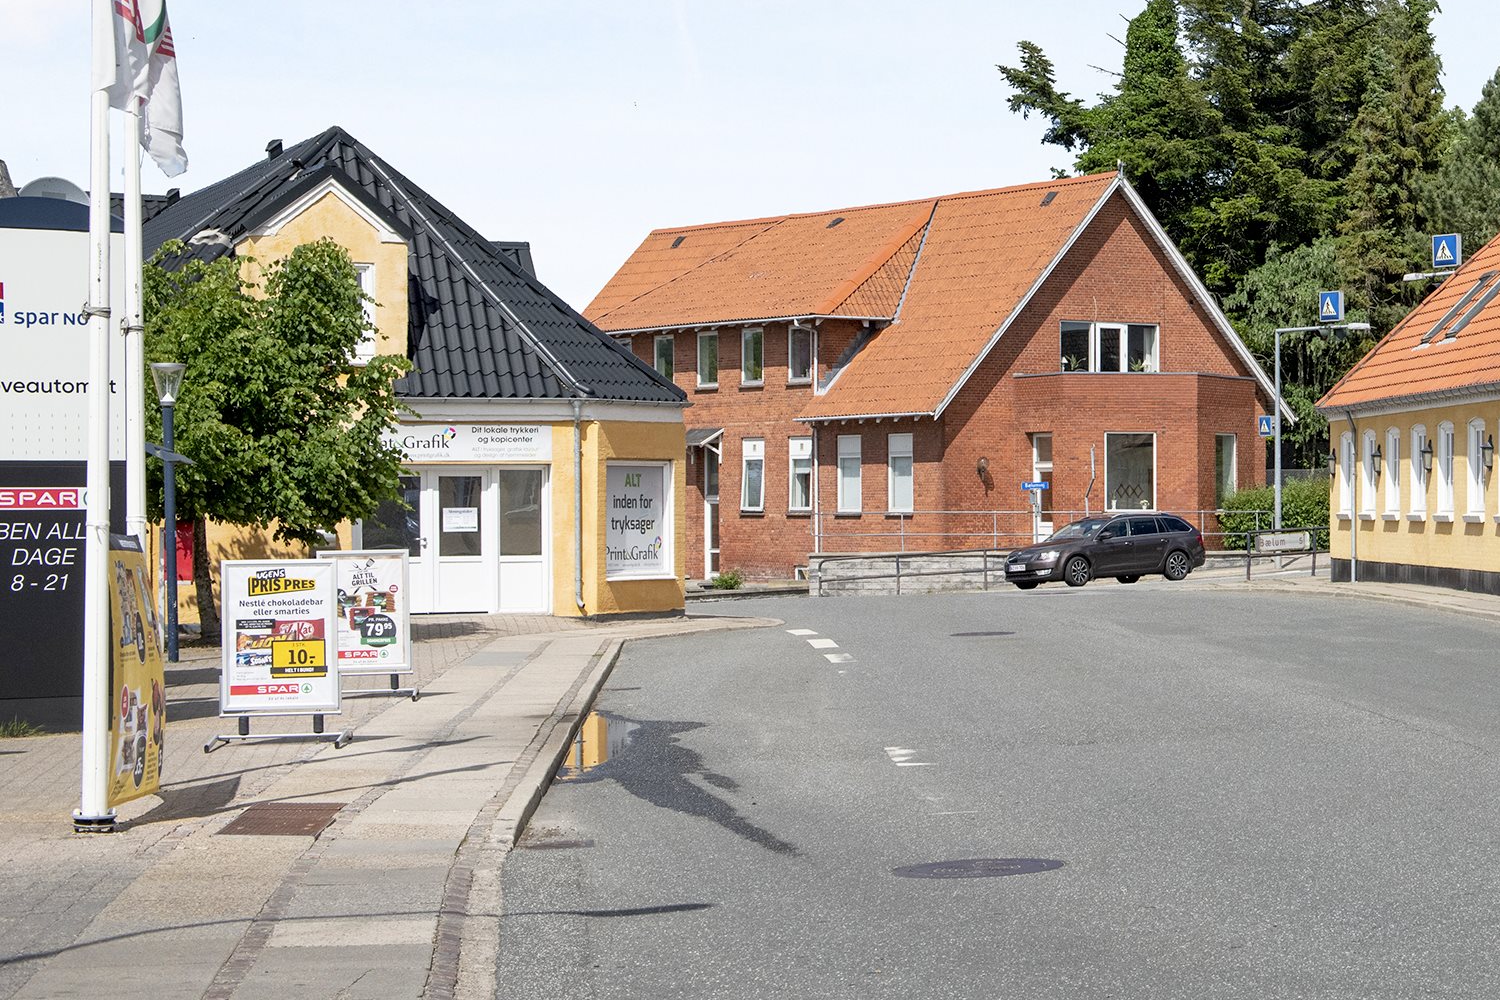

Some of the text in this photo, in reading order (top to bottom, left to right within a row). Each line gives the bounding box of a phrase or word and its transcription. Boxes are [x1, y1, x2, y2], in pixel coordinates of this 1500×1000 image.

[14, 311, 59, 328] spar
[471, 426, 539, 435] Dit lokale trykkeri
[478, 435, 533, 444] og kopicenter
[625, 473, 641, 487] ALT
[0, 491, 77, 506] SPAR
[613, 494, 653, 509] inden for
[0, 522, 86, 539] BEN ALL
[611, 515, 655, 535] tryksager
[12, 548, 77, 566] DAGE
[256, 569, 285, 580] UGENS
[10, 573, 25, 591] 8
[44, 573, 69, 591] 21
[252, 578, 315, 593] PRIS PRES
[352, 578, 378, 586] GRILLEN
[267, 598, 324, 607] chokoladebar
[253, 607, 310, 616] eller smarties
[344, 650, 378, 658] SPAR
[257, 685, 299, 694] SPAR
